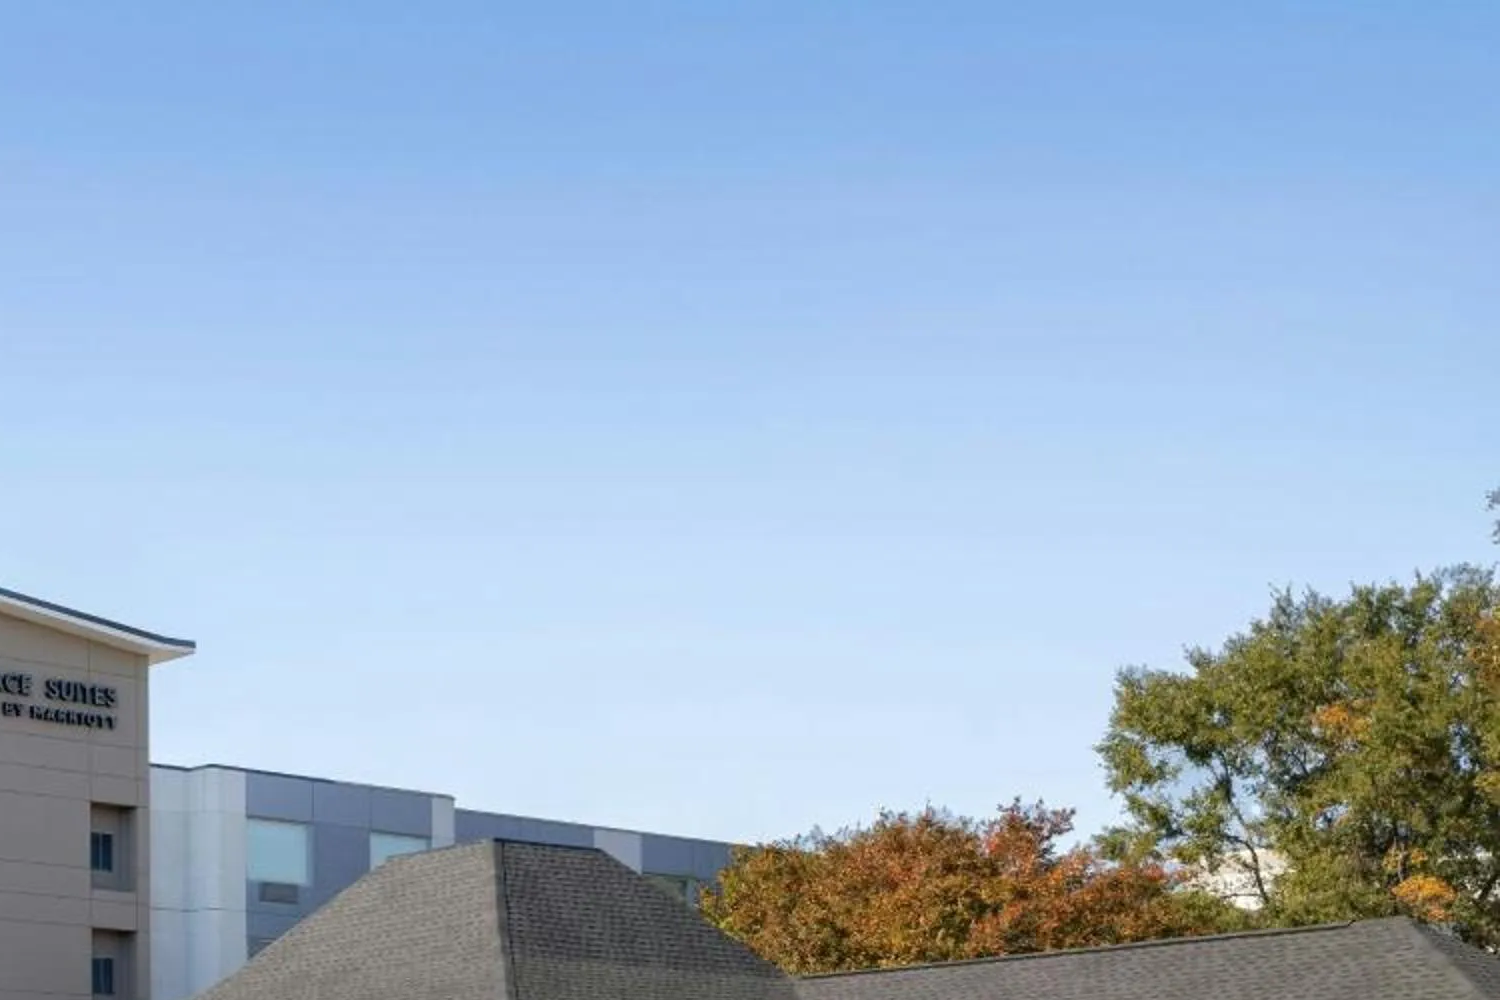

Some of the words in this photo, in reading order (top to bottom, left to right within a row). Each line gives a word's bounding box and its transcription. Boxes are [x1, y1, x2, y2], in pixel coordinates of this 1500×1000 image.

[43, 678, 117, 708] SUITES
[1, 701, 22, 718] BY
[29, 703, 117, 730] MARRIOTT
